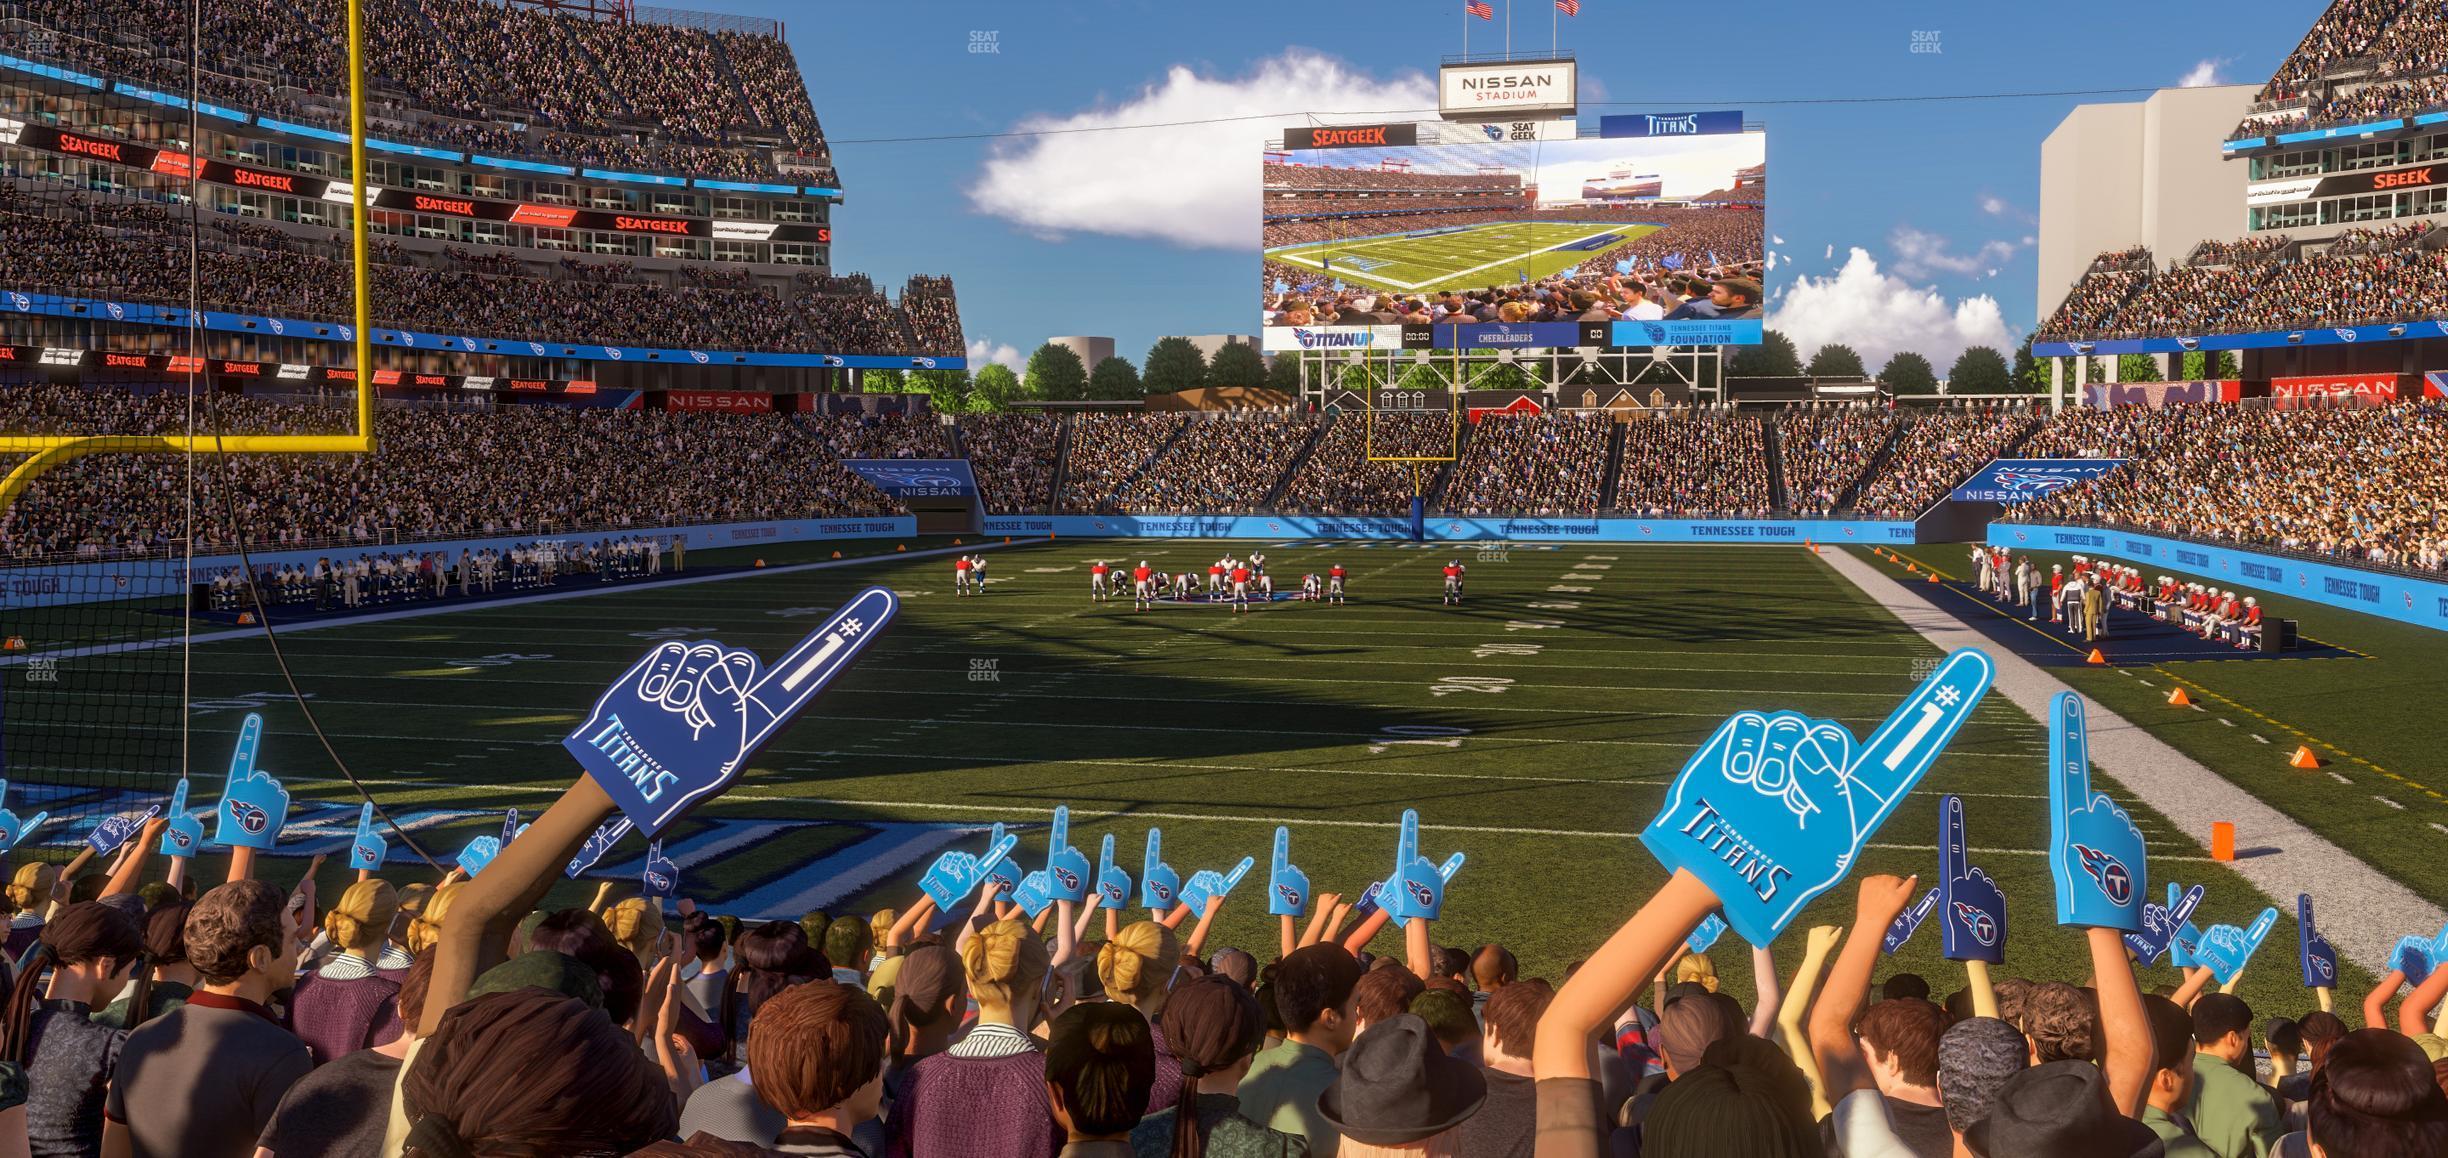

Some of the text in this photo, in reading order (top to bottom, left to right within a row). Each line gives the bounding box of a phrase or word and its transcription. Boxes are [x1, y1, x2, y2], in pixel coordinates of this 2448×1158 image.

[1462, 74, 1552, 89] NISSAN
[1476, 91, 1537, 101] STADIUM
[1512, 121, 1535, 131] SEAT
[1645, 113, 1697, 136] TITANS
[1312, 126, 1387, 147] SEATGEEK
[1511, 131, 1536, 141] GEEK
[60, 134, 121, 161] SEATGEEK
[234, 169, 293, 192] SEATGEEK
[415, 196, 474, 216] SEATGEEK
[615, 216, 689, 234] SEATGEEK
[1670, 324, 1706, 332] TENNESSEE
[1405, 331, 1430, 341] 00:00
[1478, 333, 1534, 343] CHEERLEADERS
[1670, 334, 1732, 344] FOUNDATION
[106, 352, 147, 368] SEATGEEK
[225, 362, 260, 376] SEATGEEK
[415, 375, 446, 387] SEATGEEK
[511, 380, 547, 391] SEATGEEK
[2275, 380, 2395, 396] NISSAN
[669, 395, 770, 408] NISSAN
[899, 487, 961, 496] NISSAN
[1966, 490, 2033, 501] NISSAN
[820, 522, 895, 534] TENNESSEE TOUGH
[1025, 520, 1053, 531] TOUGH
[1138, 521, 1232, 532] TENNESSEE TOUGH
[1315, 523, 1412, 533] TENNESSEE TOUGH
[1499, 524, 1599, 535] TENNESSEE TOUGH
[1690, 526, 1796, 537] TENNESSEE TOUGH
[2054, 533, 2090, 546] TENNESSEE
[2240, 561, 2283, 583] TENNESSEE TOUGH
[12, 577, 60, 597] TOUGH
[2324, 576, 2380, 604] TENNESSEE TOUGH
[1429, 676, 1516, 693] 20
[622, 730, 663, 771] TENNESSEE
[587, 713, 680, 804] TITANS
[1719, 818, 1774, 865] TENNESSEE
[1679, 797, 1793, 904] TITANS
